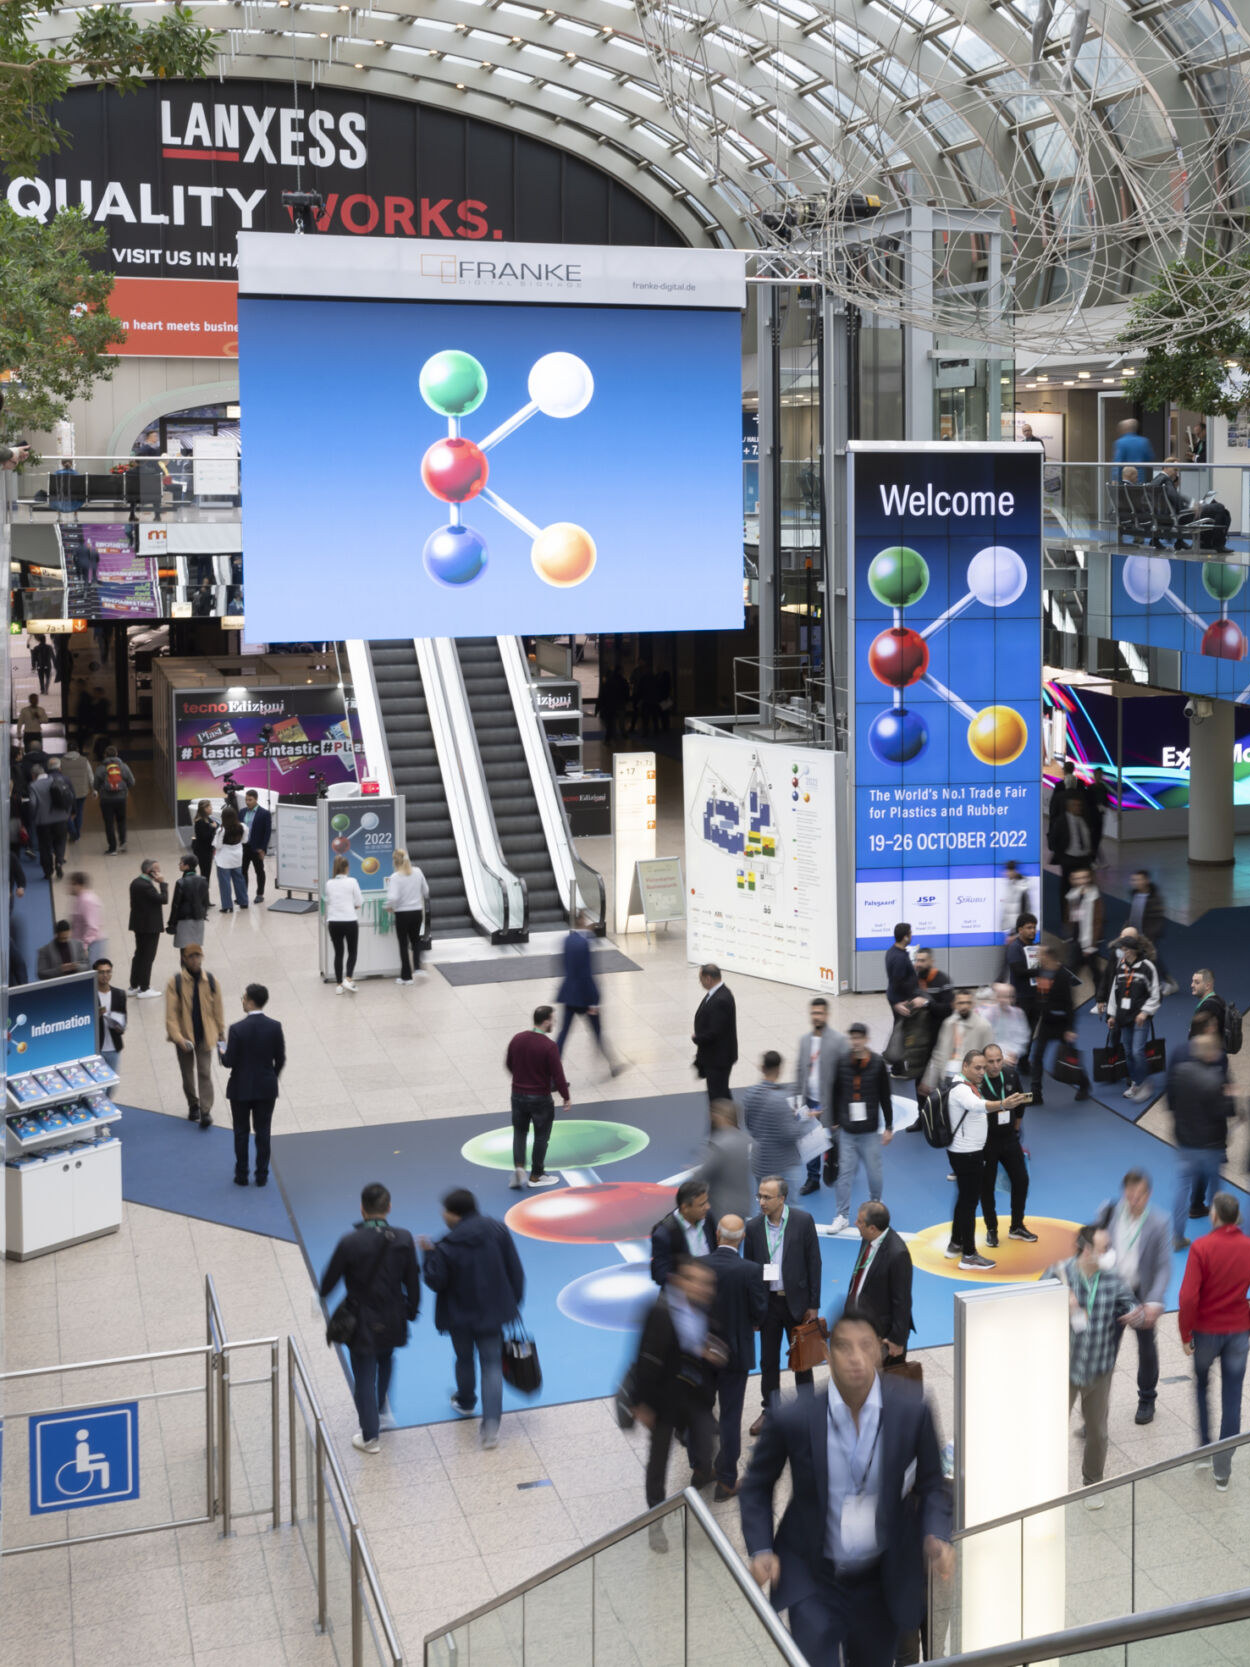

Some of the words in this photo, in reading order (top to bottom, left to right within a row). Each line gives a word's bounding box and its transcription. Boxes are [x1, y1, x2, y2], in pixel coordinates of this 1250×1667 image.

[161, 100, 368, 169] LANXESS
[6, 176, 267, 229] QUALITY
[112, 248, 163, 264] VISIT
[166, 250, 192, 265] US
[197, 252, 216, 266] IN
[458, 261, 582, 282] FRANKE
[632, 281, 696, 292] franke-digital.de
[133, 319, 164, 331] heart
[166, 322, 201, 332] meets
[204, 321, 239, 332] busine
[879, 483, 1015, 517] Welcome
[181, 743, 320, 760] #PlasticIsFantastic
[869, 789, 891, 802] The
[894, 787, 938, 801] World's
[942, 788, 966, 800] No.1
[969, 786, 1001, 799] Trade
[1004, 785, 1027, 798] Fair
[869, 806, 886, 819] for
[889, 805, 937, 819] Plastics
[940, 805, 963, 817] and
[967, 804, 1009, 817] Rubber
[364, 832, 393, 846] 2022
[917, 831, 986, 851] OCTOBER
[989, 830, 1027, 849] 2022
[31, 1014, 91, 1038] Information
